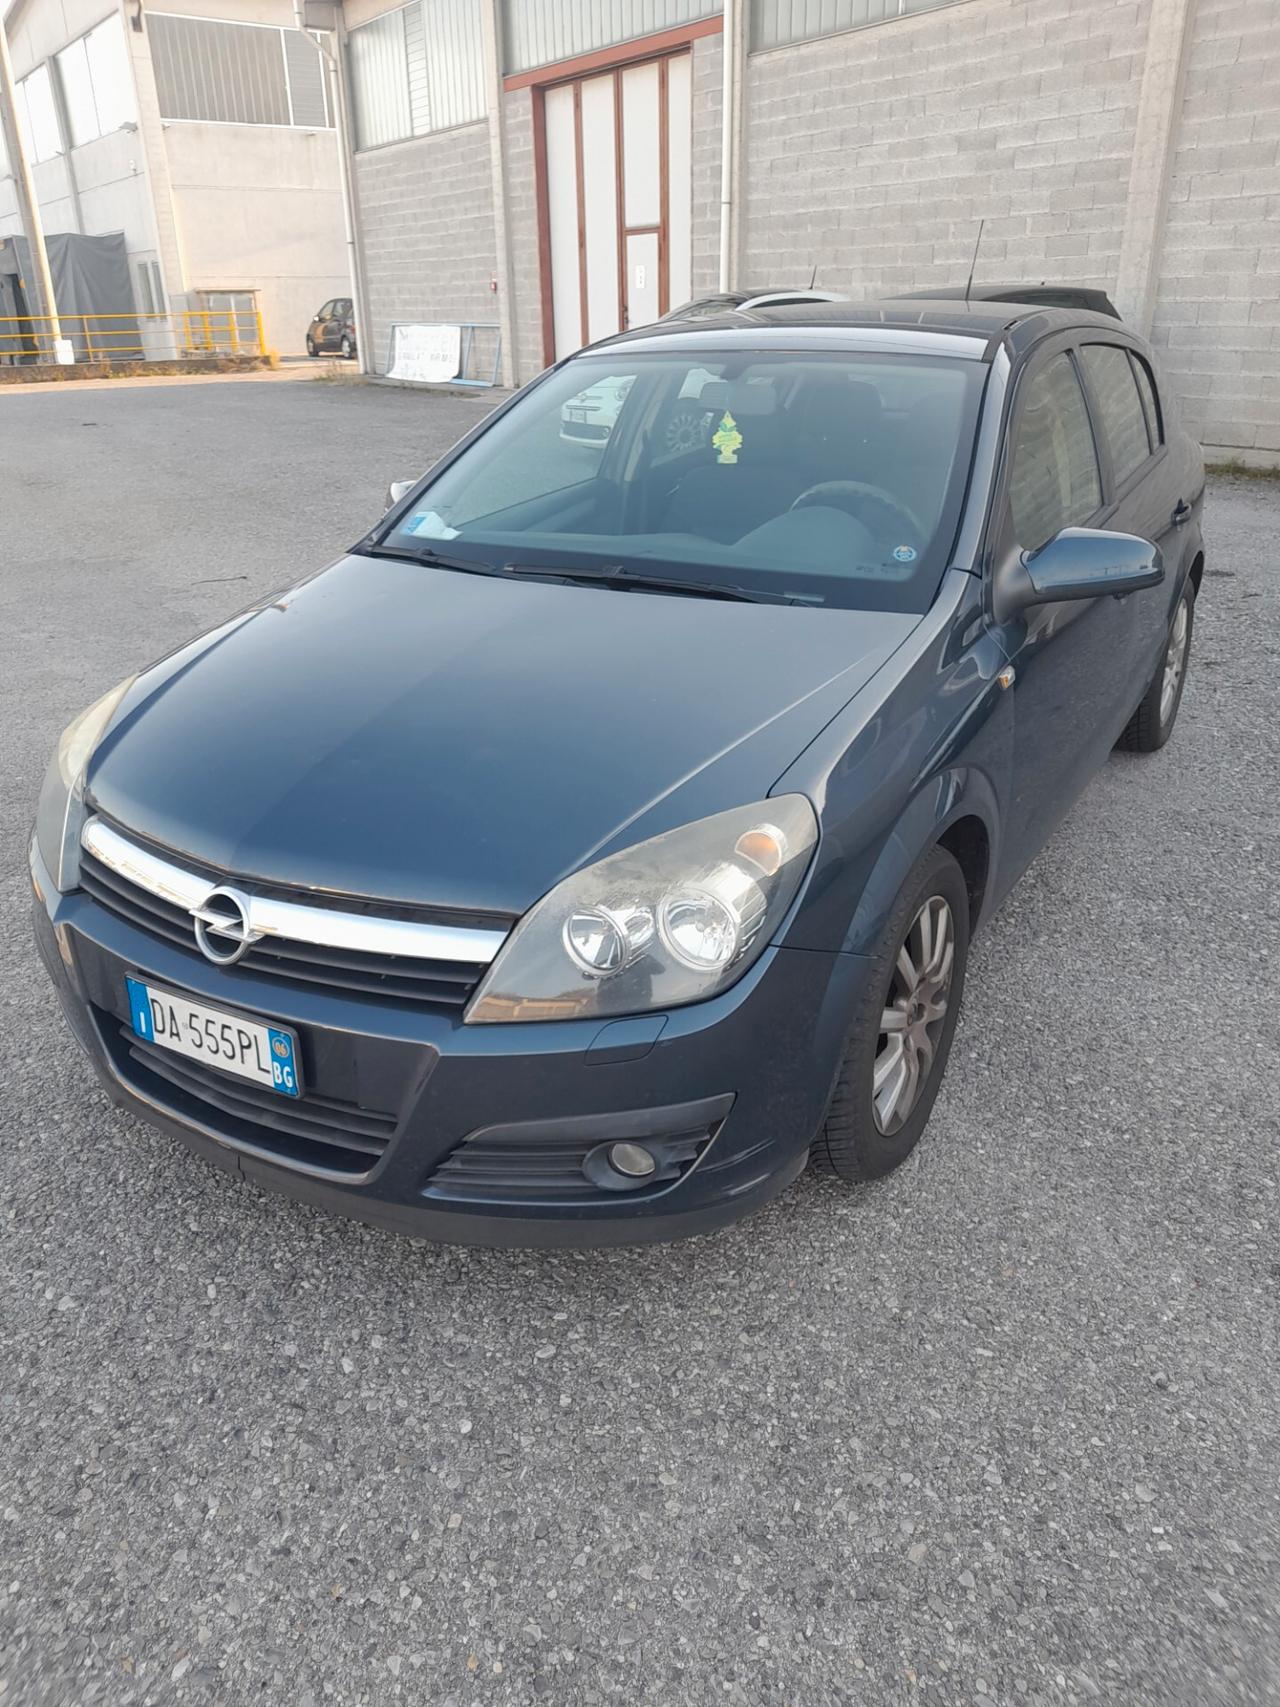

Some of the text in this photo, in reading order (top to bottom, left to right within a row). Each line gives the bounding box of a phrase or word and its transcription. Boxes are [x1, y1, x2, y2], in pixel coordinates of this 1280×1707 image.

[151, 998, 271, 1075] DA 555PL
[272, 1062, 293, 1088] BG
